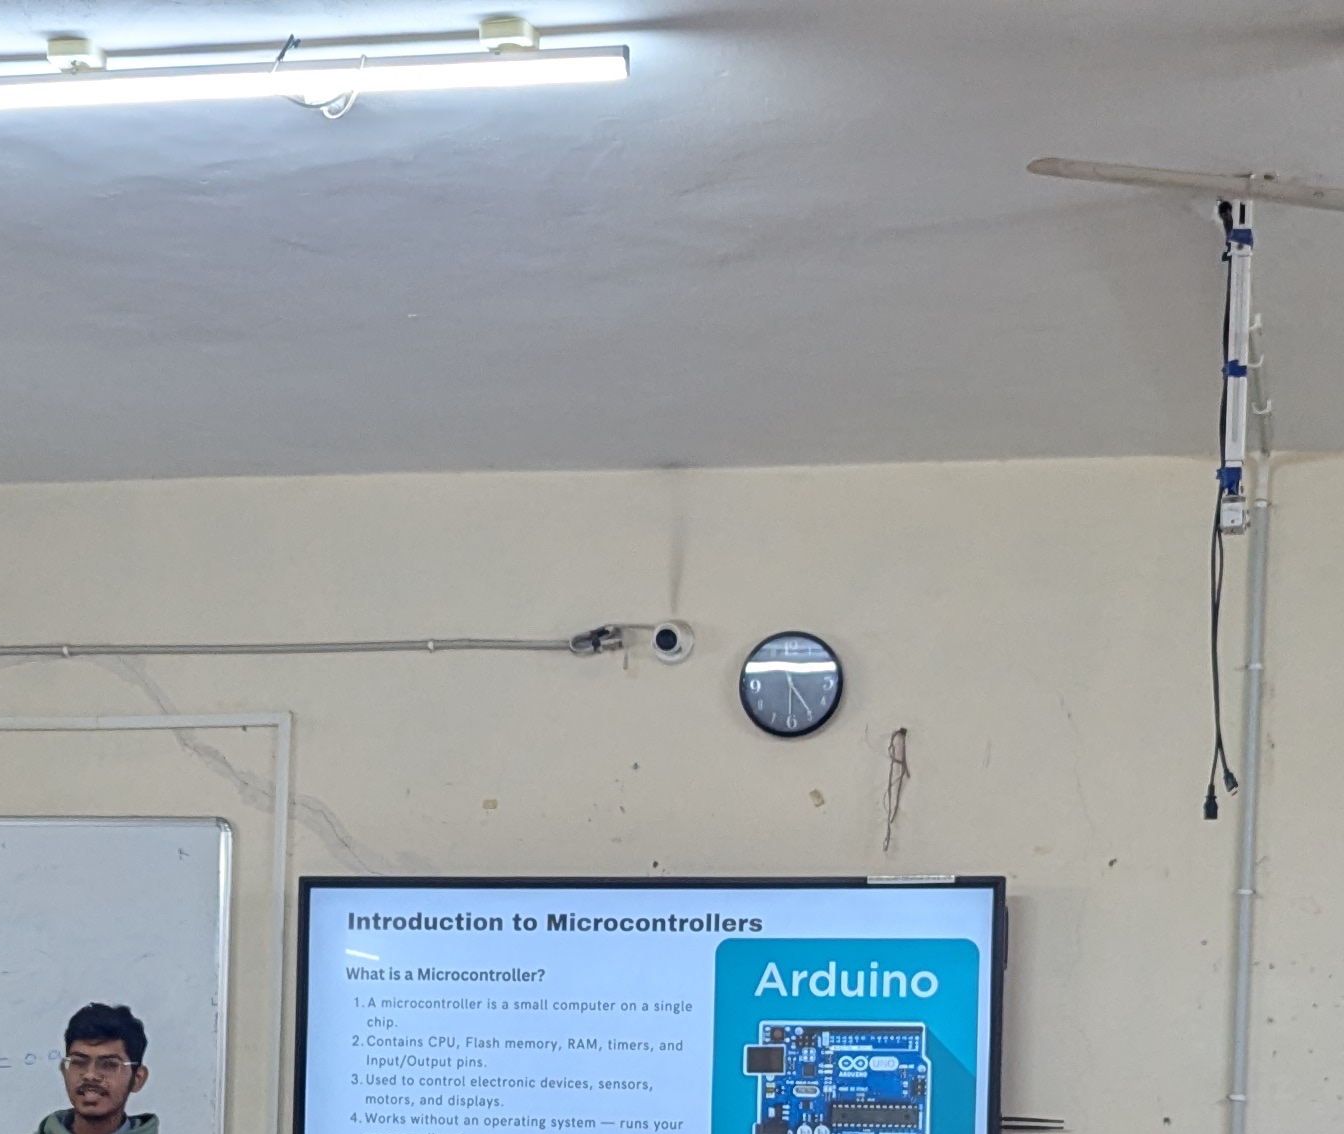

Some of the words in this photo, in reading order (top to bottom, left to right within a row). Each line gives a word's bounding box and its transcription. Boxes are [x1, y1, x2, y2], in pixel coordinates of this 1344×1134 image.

[749, 679, 761, 693] 9
[786, 714, 797, 730] 6
[347, 911, 504, 932] Introduction
[511, 912, 538, 932] to
[546, 912, 763, 933] Microcontrollers
[345, 966, 386, 981] What
[388, 966, 402, 981] is
[404, 969, 414, 981] a
[417, 966, 546, 983] Microcontroller?
[755, 961, 939, 998] Arduino
[353, 996, 365, 1008] 1.
[367, 996, 377, 1008] A
[380, 996, 483, 1010] microcontroller
[486, 998, 498, 1010] is
[501, 1000, 509, 1010] a
[513, 998, 549, 1011] small
[552, 1000, 617, 1014] computer
[620, 1002, 637, 1012] on
[641, 1002, 649, 1012] a
[653, 1000, 693, 1015] single
[366, 1016, 398, 1031] chip.
[351, 1034, 365, 1047] 2.
[366, 1034, 424, 1048] Contains
[427, 1035, 461, 1050] CPU,
[465, 1036, 500, 1049] Flash
[504, 1039, 563, 1053] memory,
[567, 1037, 603, 1052] RAM,
[607, 1038, 654, 1053] timers,
[658, 1039, 684, 1052] and
[366, 1054, 452, 1070] Input/Output
[456, 1056, 488, 1071] pins.
[350, 1072, 364, 1086] 3.
[365, 1073, 397, 1086] Used
[401, 1075, 415, 1087] to
[418, 1075, 466, 1087] control
[469, 1075, 536, 1089] electronic
[539, 1076, 593, 1091] devices,
[598, 1080, 653, 1093] sensors,
[365, 1094, 415, 1108] motors,
[419, 1094, 443, 1106] and
[447, 1094, 505, 1110] displays.
[349, 1111, 363, 1124] 4.
[364, 1112, 407, 1125] Works
[410, 1113, 459, 1126] without
[463, 1116, 479, 1126] an
[483, 1115, 547, 1131] operating
[550, 1117, 596, 1131] system
[619, 1119, 649, 1130] runs
[653, 1120, 684, 1133] your
